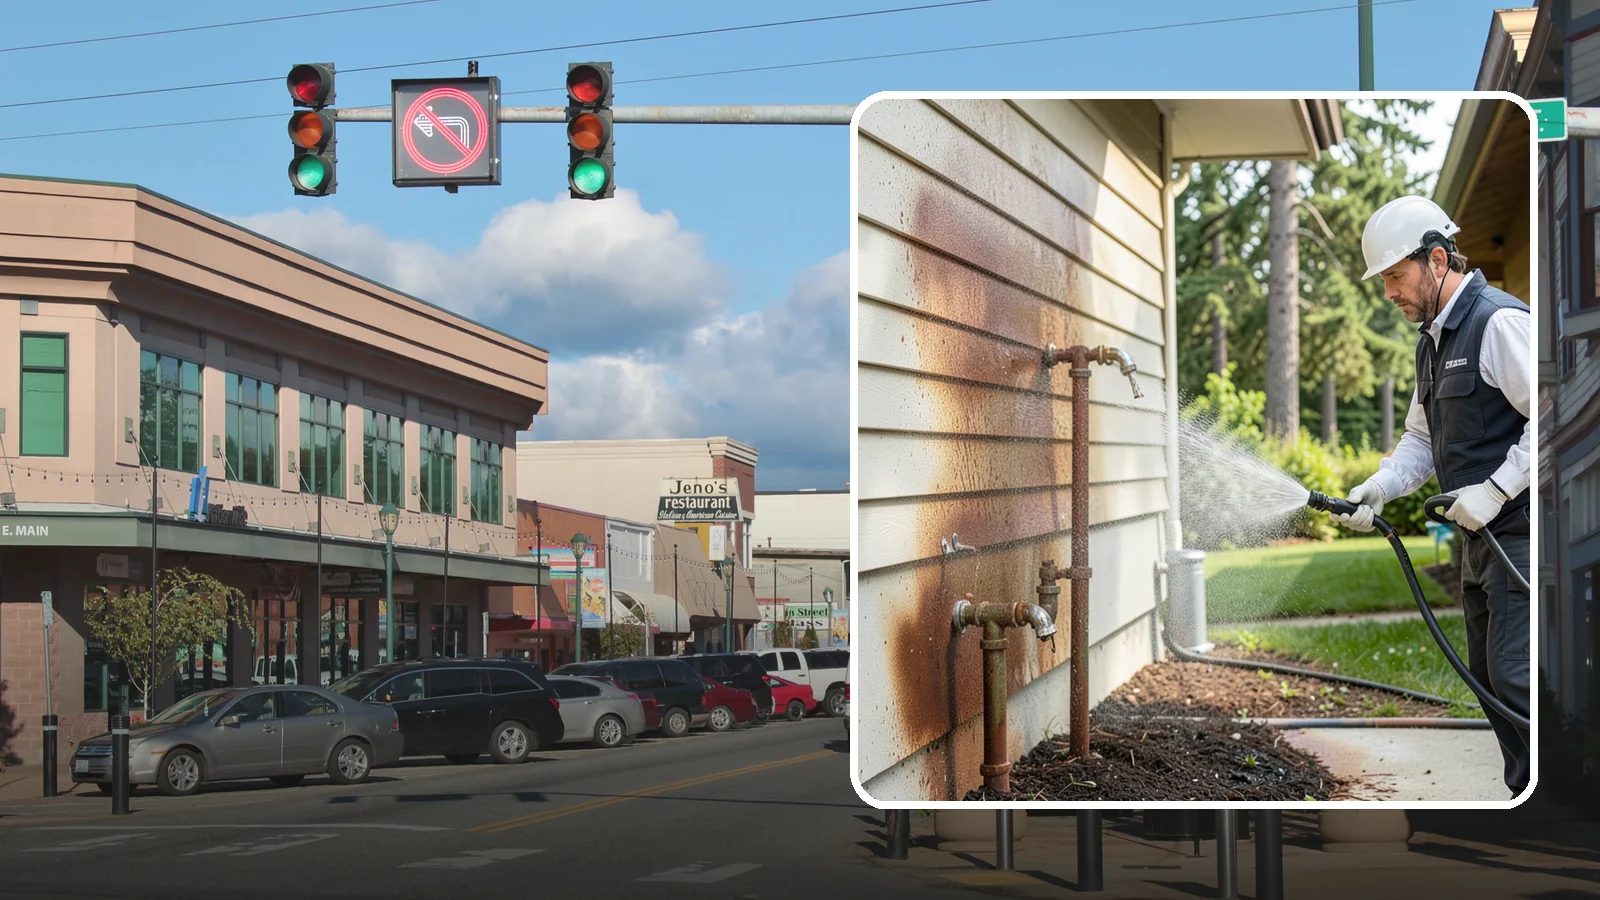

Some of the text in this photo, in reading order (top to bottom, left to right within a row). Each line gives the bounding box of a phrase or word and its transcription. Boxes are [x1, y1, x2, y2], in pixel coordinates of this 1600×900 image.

[670, 480, 727, 494] Jeno's
[665, 496, 731, 509] restaurant
[659, 510, 681, 519] Italian
[686, 510, 714, 519] American
[715, 510, 737, 519] Cuisine
[2, 525, 49, 536] E. MAIN
[797, 608, 828, 616] Street
[791, 619, 823, 627] lass
